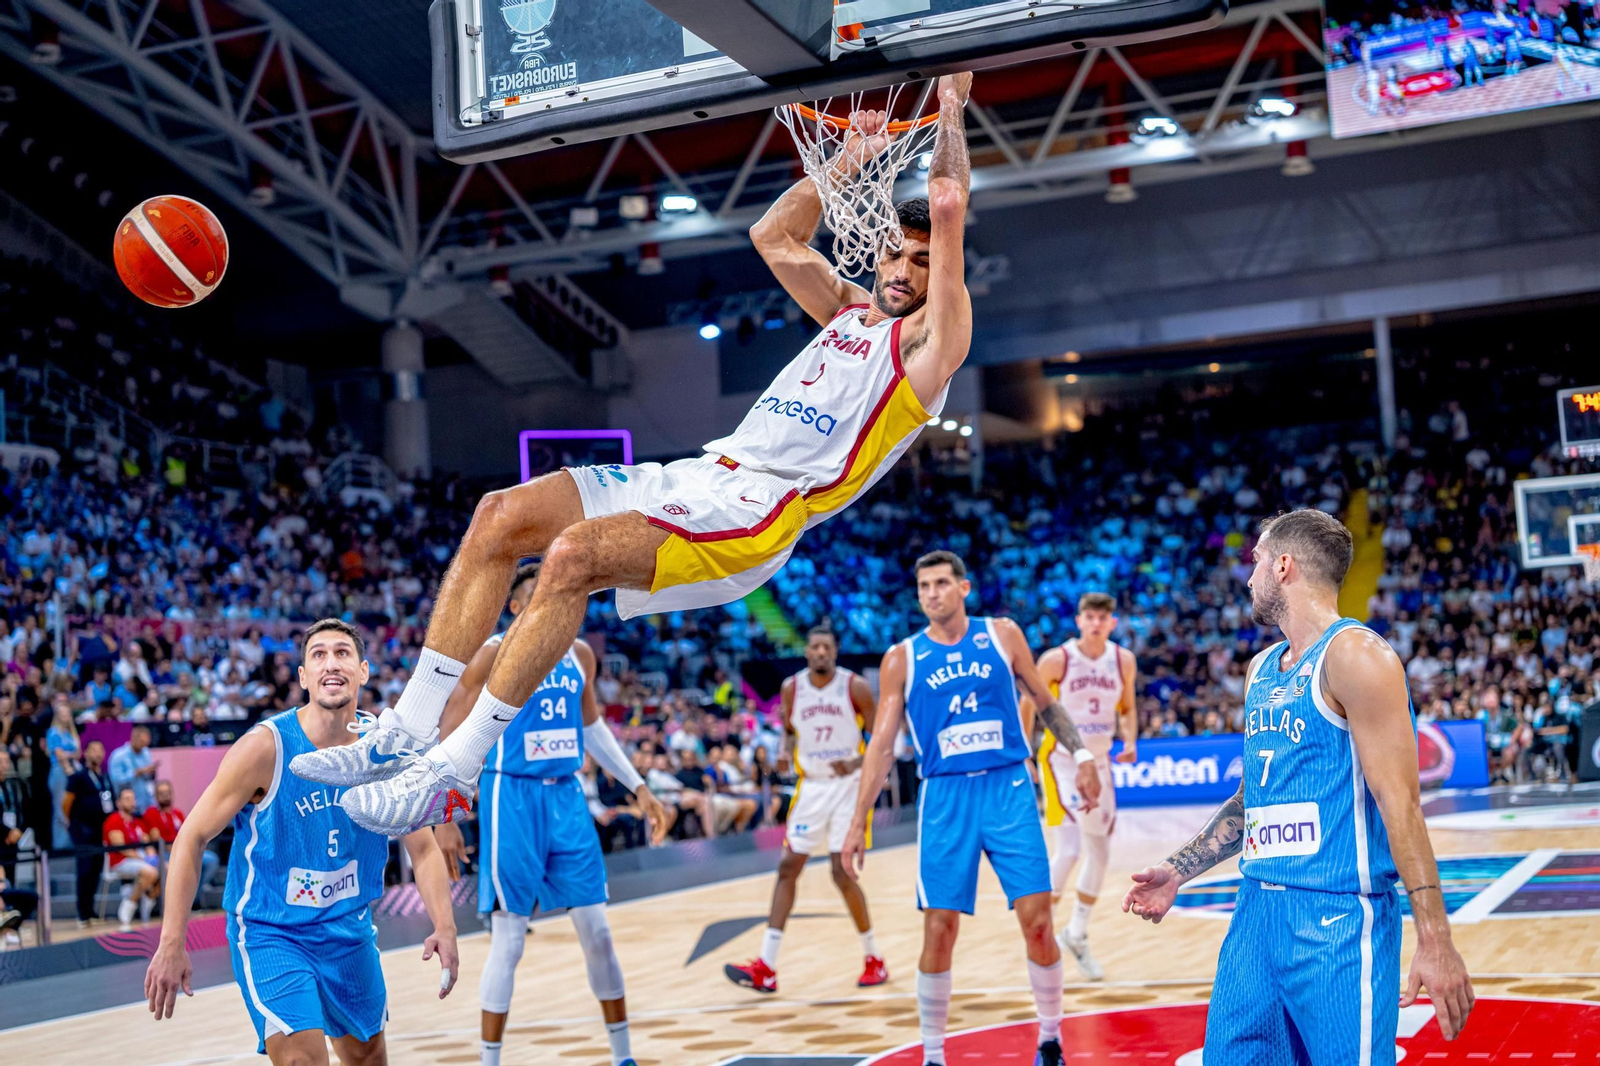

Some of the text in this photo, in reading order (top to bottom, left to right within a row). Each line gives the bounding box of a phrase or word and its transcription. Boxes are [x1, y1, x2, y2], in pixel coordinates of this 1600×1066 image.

[179, 223, 201, 248] FIBA
[534, 672, 579, 694] LLAS
[926, 661, 992, 690] HELLAS
[540, 696, 567, 721] 34
[948, 691, 978, 715] 44
[1089, 697, 1100, 715] 3
[813, 725, 834, 743] 77
[1112, 755, 1219, 788] molten
[1258, 749, 1275, 787] 7
[294, 788, 343, 818] HELL
[327, 829, 340, 858] 5
